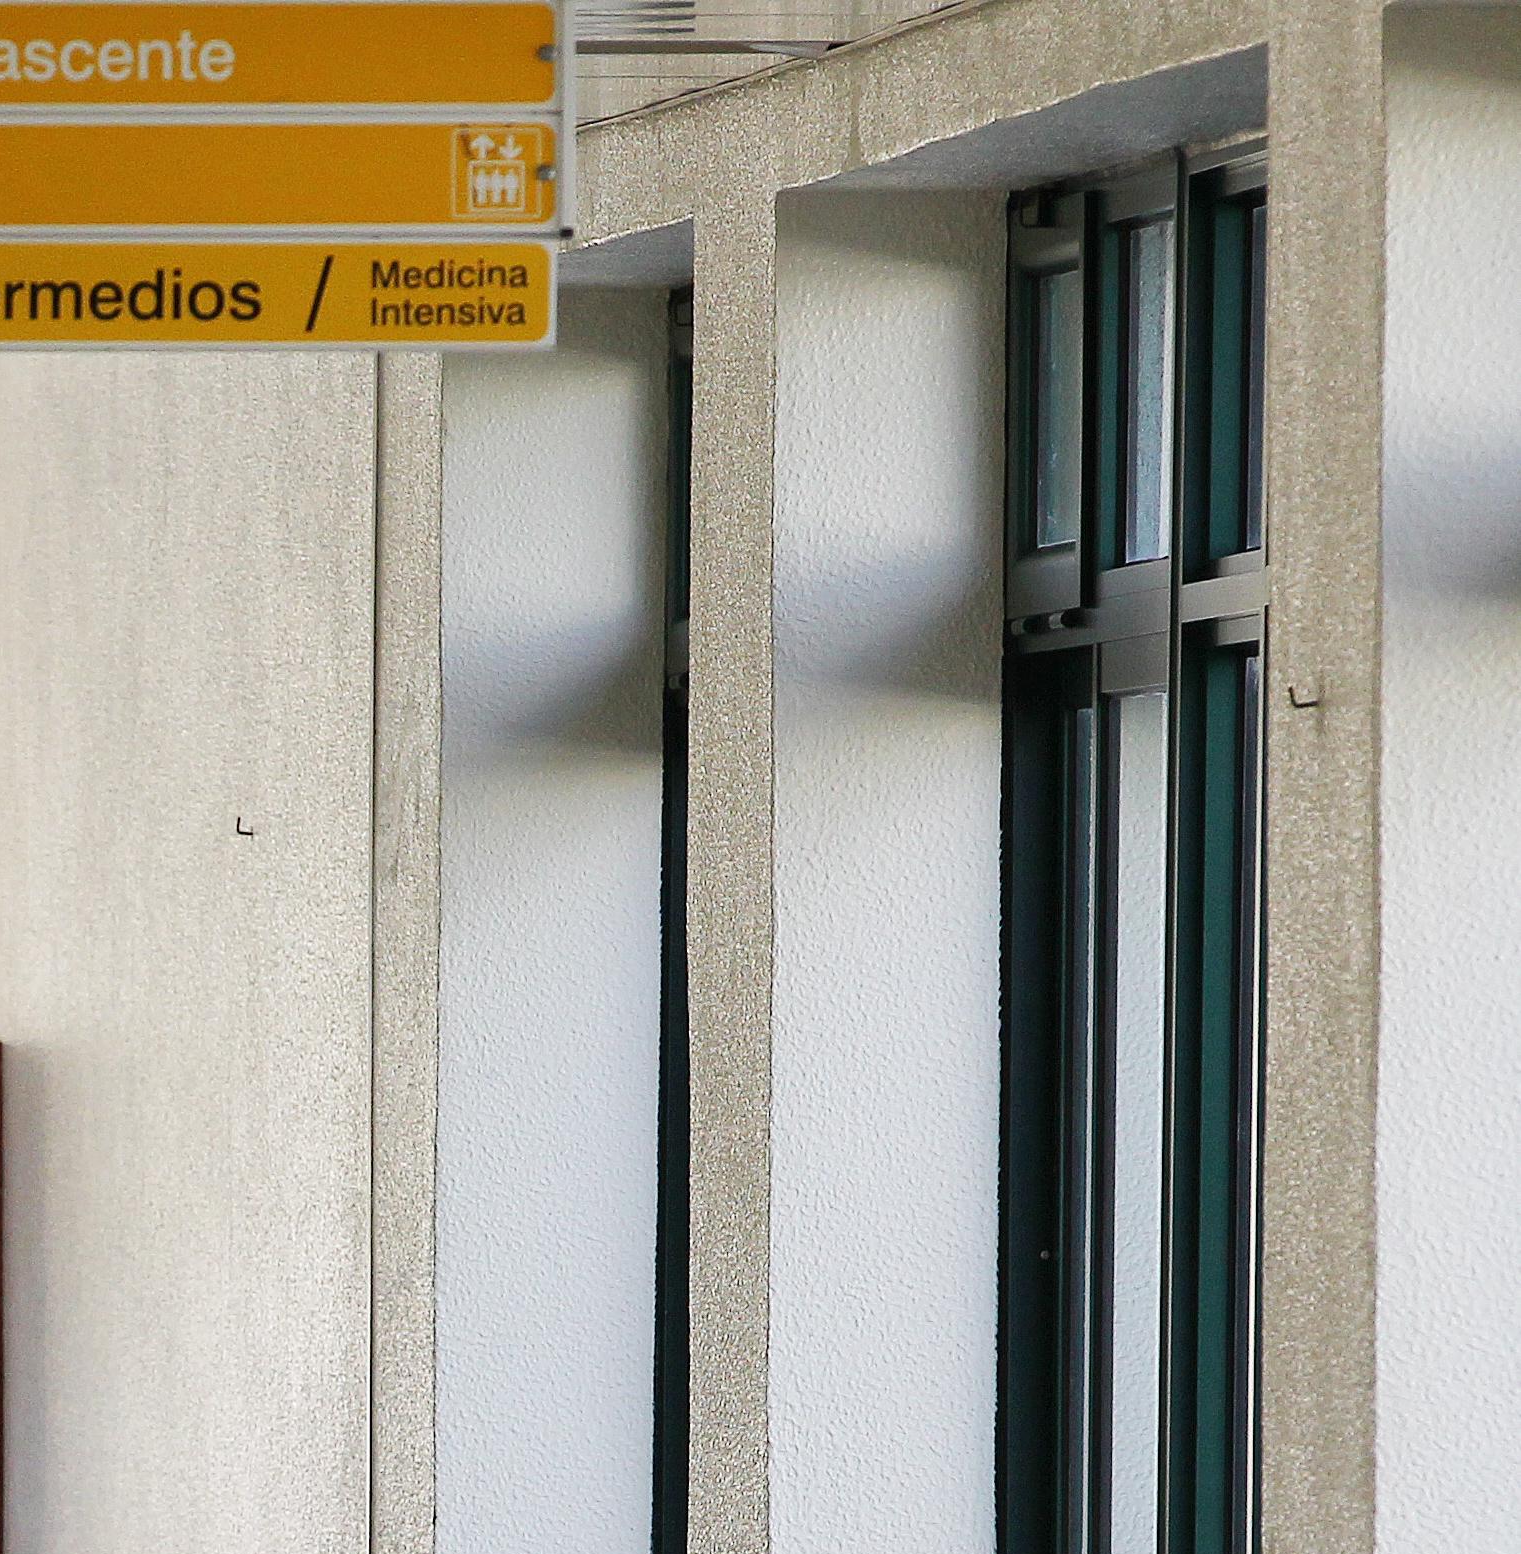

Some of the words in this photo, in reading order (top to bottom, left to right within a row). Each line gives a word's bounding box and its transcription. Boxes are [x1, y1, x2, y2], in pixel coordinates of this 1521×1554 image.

[369, 259, 529, 293] Medicina
[305, 255, 335, 333] /
[369, 296, 528, 330] Intensiva
